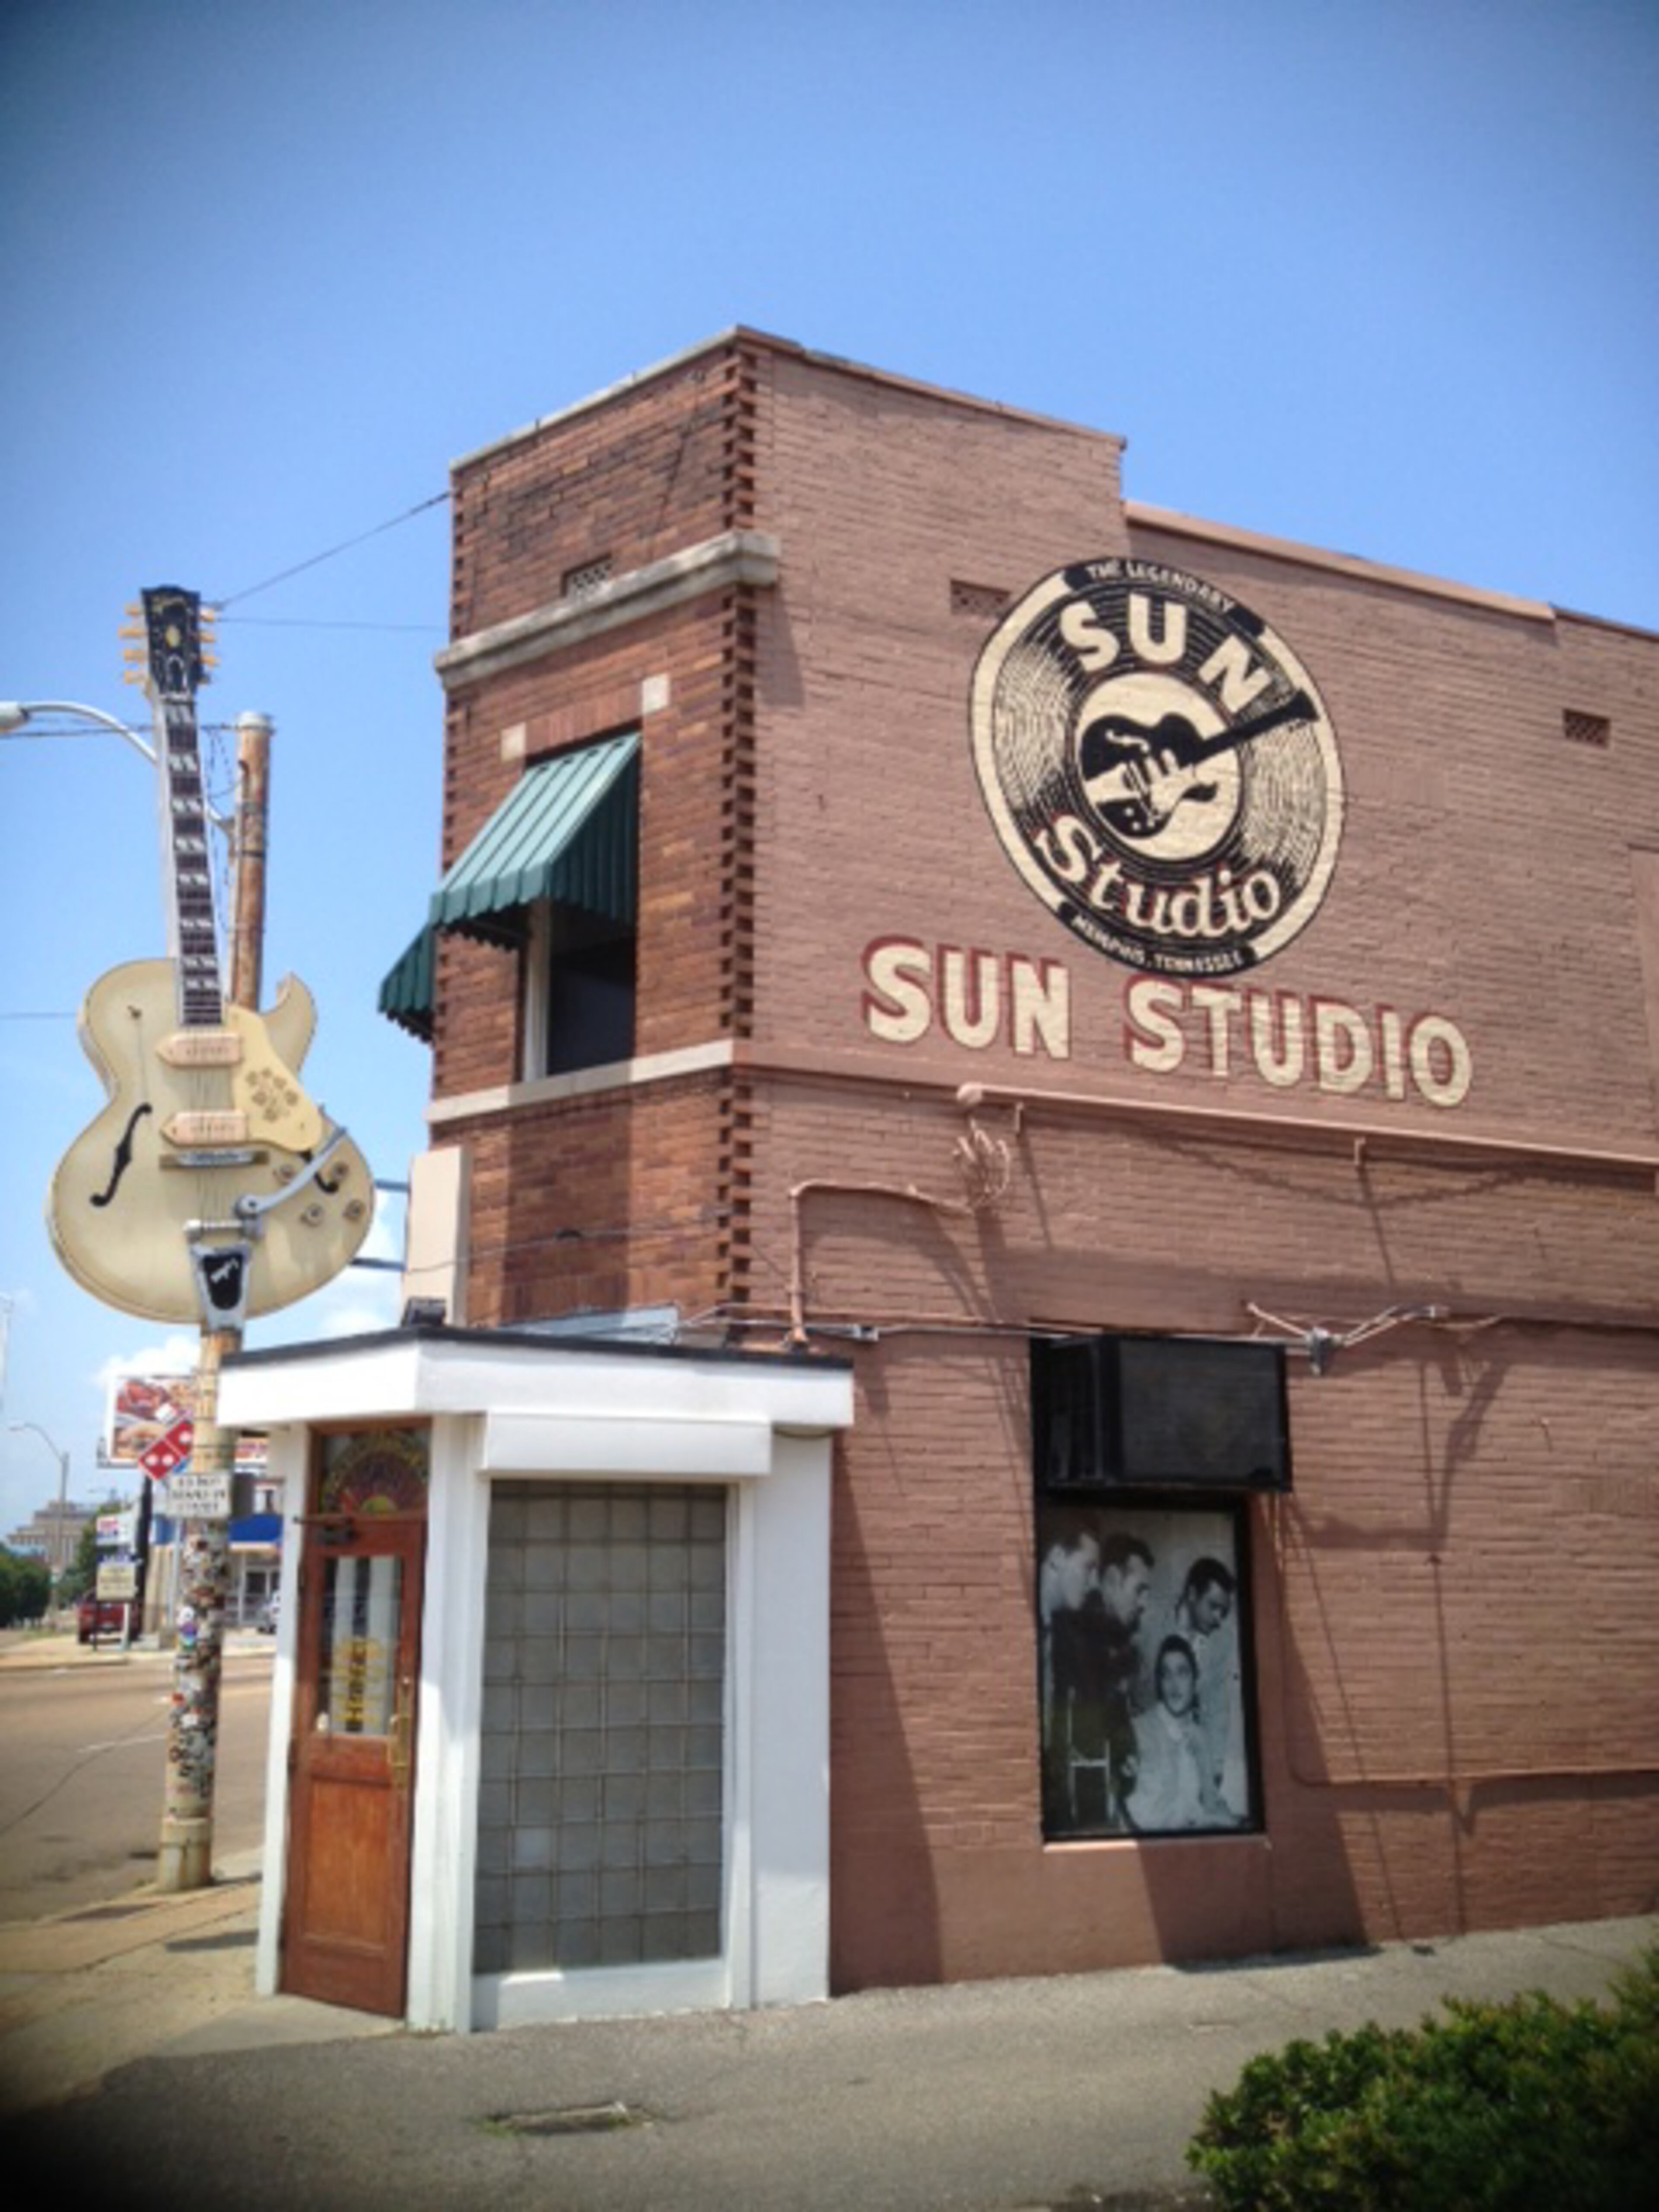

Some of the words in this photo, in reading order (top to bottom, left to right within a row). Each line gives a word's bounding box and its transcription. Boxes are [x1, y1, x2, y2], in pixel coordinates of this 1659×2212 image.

[1086, 560, 1123, 579] THE
[1126, 561, 1235, 613] LEGENDARY
[1059, 592, 1271, 714] SUN
[1035, 814, 1281, 938] Studio
[863, 936, 1070, 1059] SUN
[1125, 973, 1471, 1108] STUDIO
